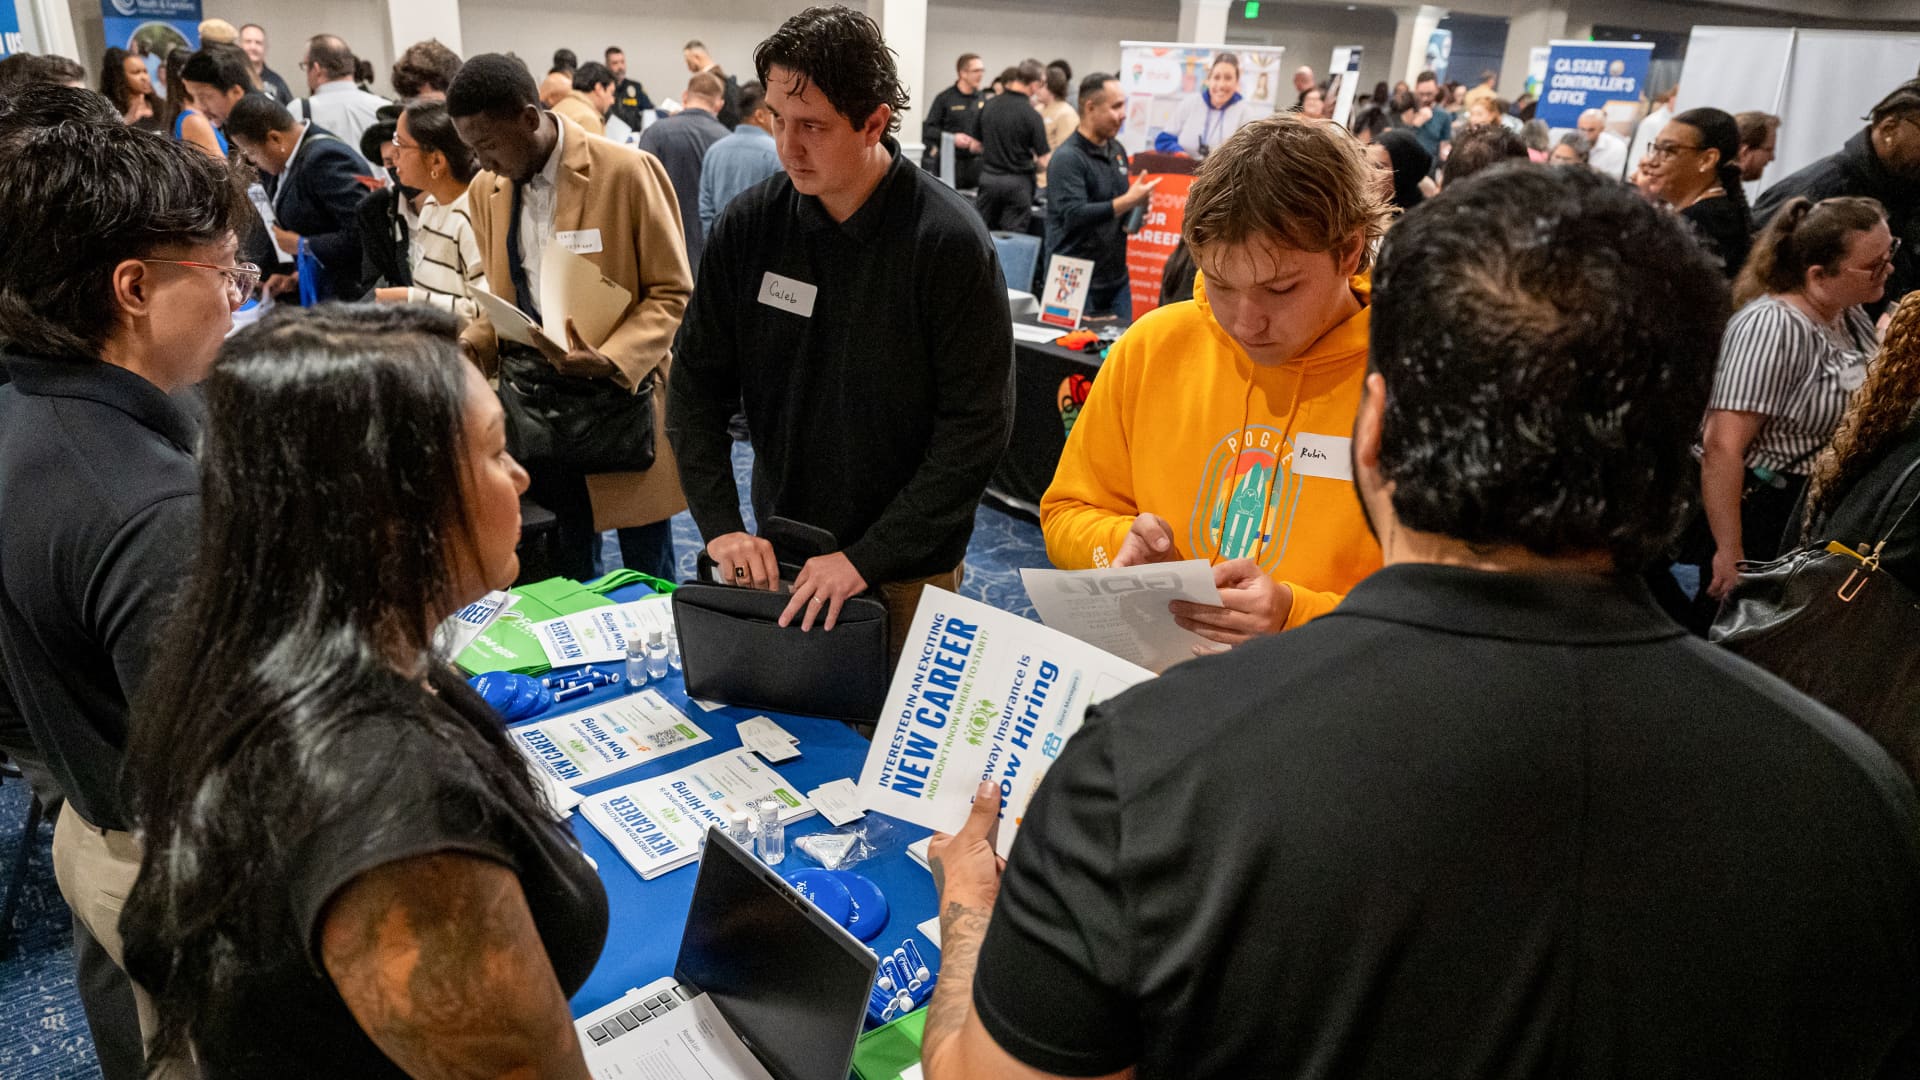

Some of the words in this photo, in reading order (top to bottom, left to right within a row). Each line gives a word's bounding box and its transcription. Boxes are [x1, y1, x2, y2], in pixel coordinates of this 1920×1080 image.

[1555, 58, 1571, 73] CA
[1571, 59, 1607, 75] STATE
[1550, 74, 1635, 93] CONTROLLER'S
[1547, 89, 1587, 106] OFFICE
[769, 280, 797, 303] Caleb
[1299, 447, 1327, 460] Rubin
[549, 620, 575, 644] CAREER
[601, 612, 619, 633] Hiring
[610, 633, 627, 650] Now
[917, 612, 945, 671] EXCITING
[910, 672, 925, 692] AN
[914, 616, 978, 729] CAREER
[904, 692, 917, 707] IN
[991, 668, 1026, 741] Insurance
[1016, 654, 1031, 666] is
[1008, 659, 1059, 750] Hiring
[579, 717, 612, 742] Hiring
[926, 778, 939, 800] AND
[943, 716, 960, 747] KNOW
[953, 681, 972, 714] WHERE
[966, 665, 977, 679] TO
[522, 729, 564, 761] CAREER
[602, 740, 630, 759] Now
[878, 707, 912, 787] INTERESTED
[550, 759, 583, 780] NEW
[891, 730, 939, 798] NEW
[662, 791, 690, 815] Insurance
[669, 781, 707, 810] Hiring
[608, 795, 657, 833] CAREER
[628, 832, 658, 859] INTERESTED
[642, 831, 679, 856] NEW
